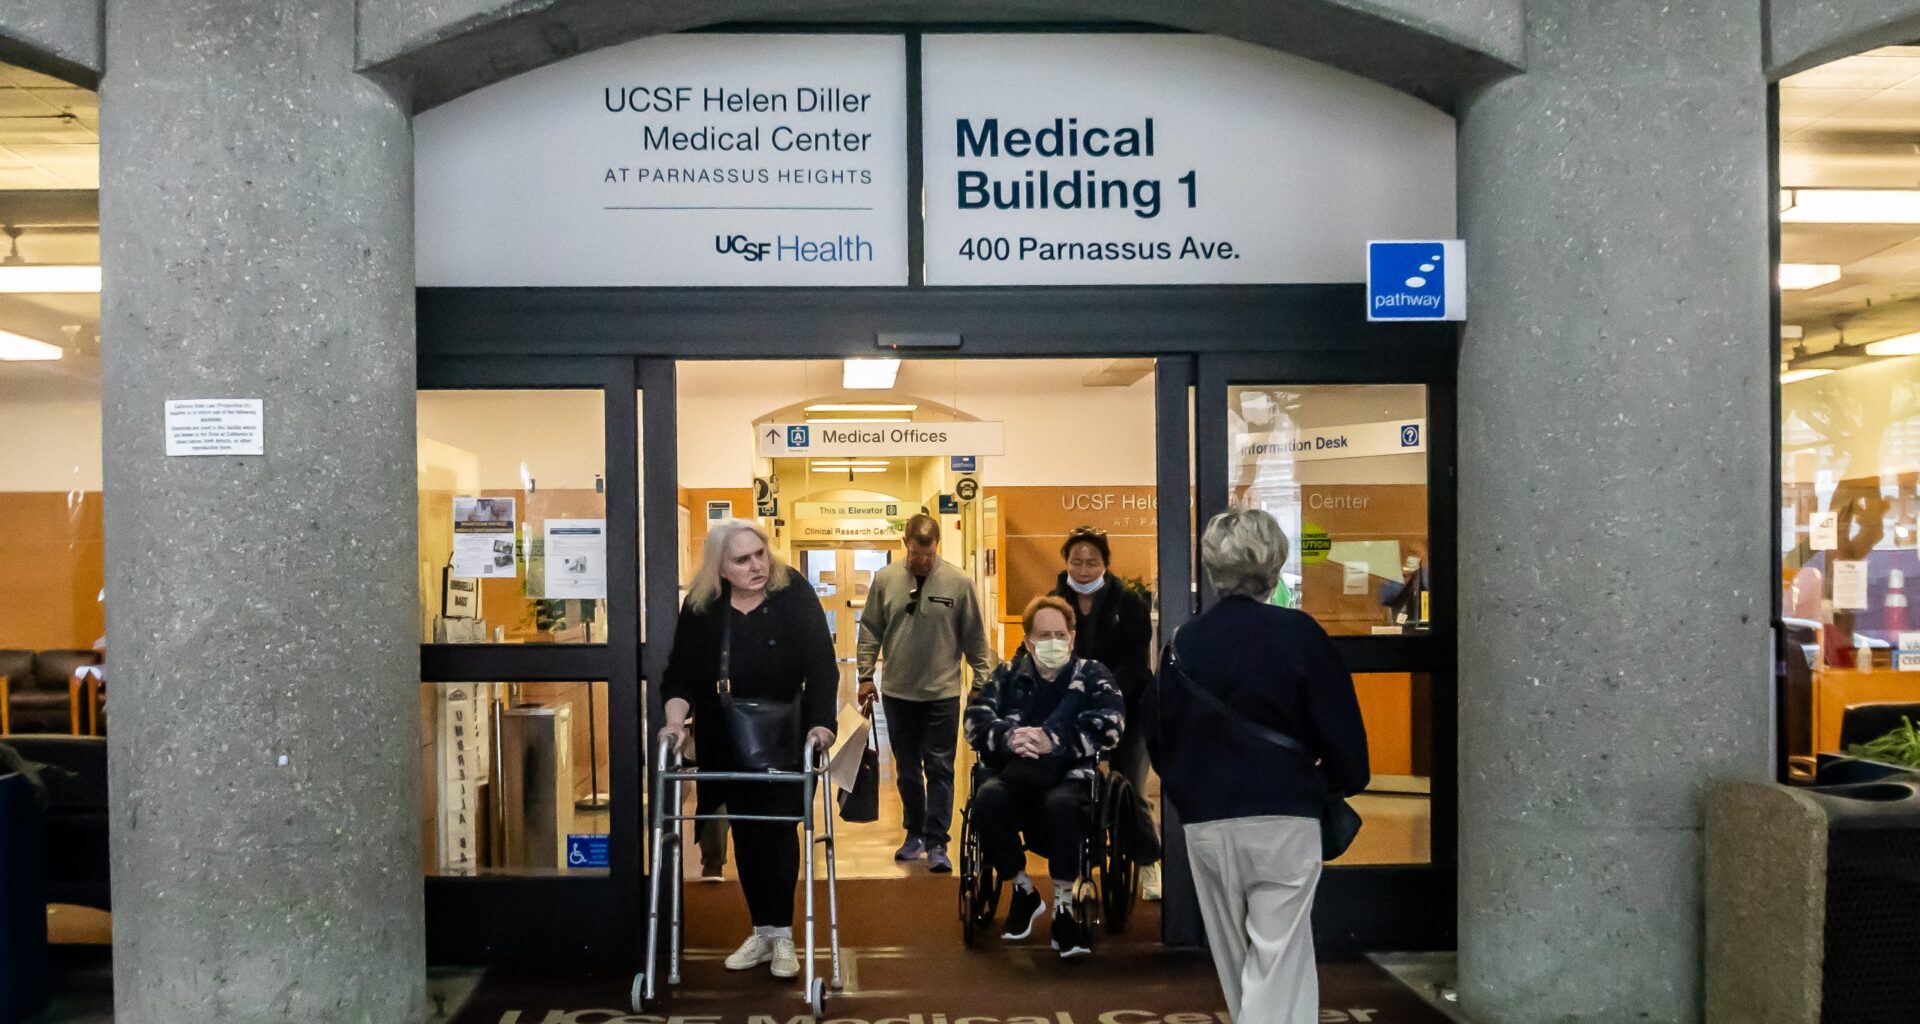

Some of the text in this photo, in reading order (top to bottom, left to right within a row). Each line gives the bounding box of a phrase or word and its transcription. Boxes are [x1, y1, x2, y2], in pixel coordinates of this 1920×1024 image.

[605, 86, 871, 113] UCSF Helen Diller
[643, 125, 872, 152] Medical Center
[956, 117, 1155, 158] Medical
[604, 167, 872, 186] AT PARNASSUS HEIGHTS
[957, 169, 1198, 219] Building 1
[715, 234, 873, 263] UCSF Health
[958, 236, 1241, 262] 400 Parnassus Ave.
[1375, 291, 1441, 310] pathway
[822, 428, 948, 444] Medical Offices
[1315, 435, 1349, 451] Desk
[820, 506, 836, 515] This
[848, 506, 884, 515] Elevator
[1061, 493, 1158, 511] UCSF Hele
[1309, 492, 1370, 510] Center
[804, 527, 833, 536] Clinical
[835, 527, 872, 536] Research
[1113, 517, 1131, 527] AT
